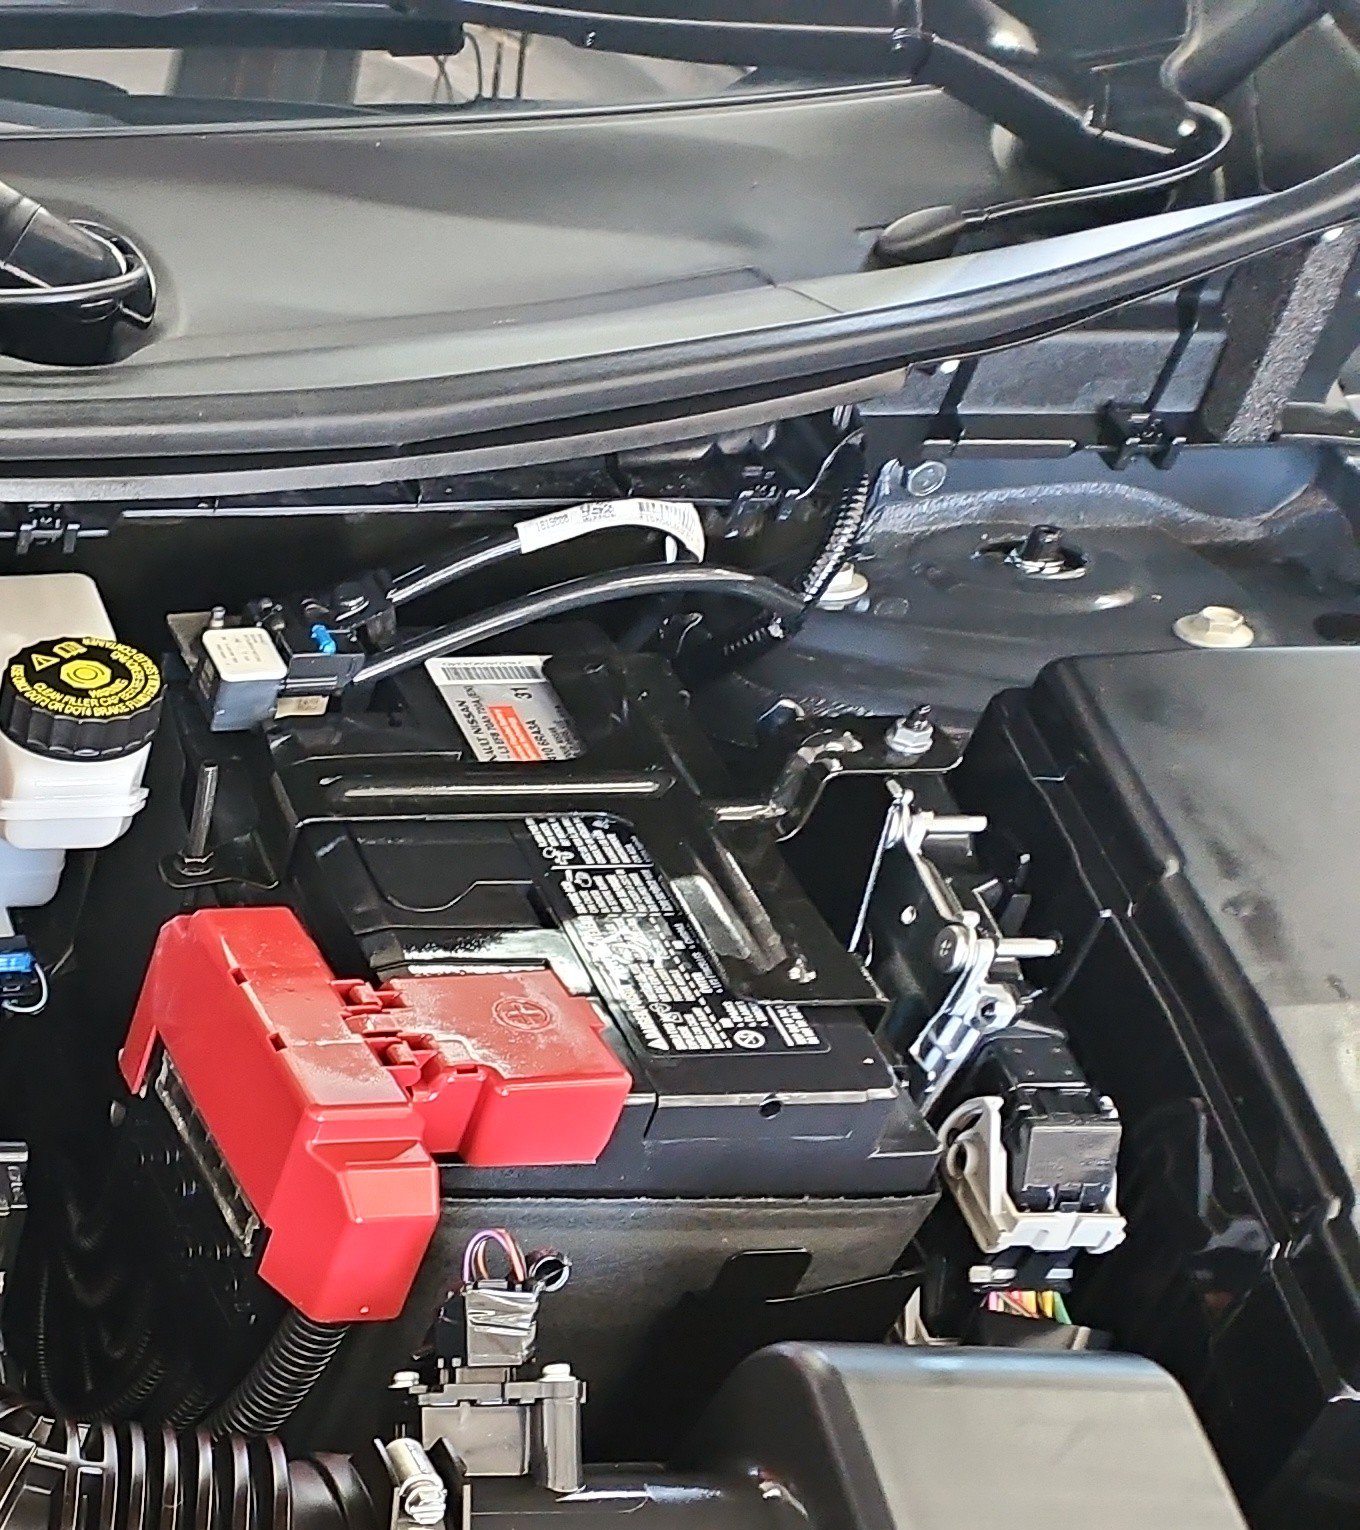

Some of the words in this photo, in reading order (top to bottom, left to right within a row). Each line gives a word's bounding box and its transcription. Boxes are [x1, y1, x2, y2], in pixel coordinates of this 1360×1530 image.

[34, 682, 64, 702] CLEAN
[64, 694, 99, 707] FILLER
[510, 686, 533, 699] 31
[48, 702, 64, 713] OR
[93, 704, 126, 716] BRAKE
[455, 699, 484, 735] NISSAN
